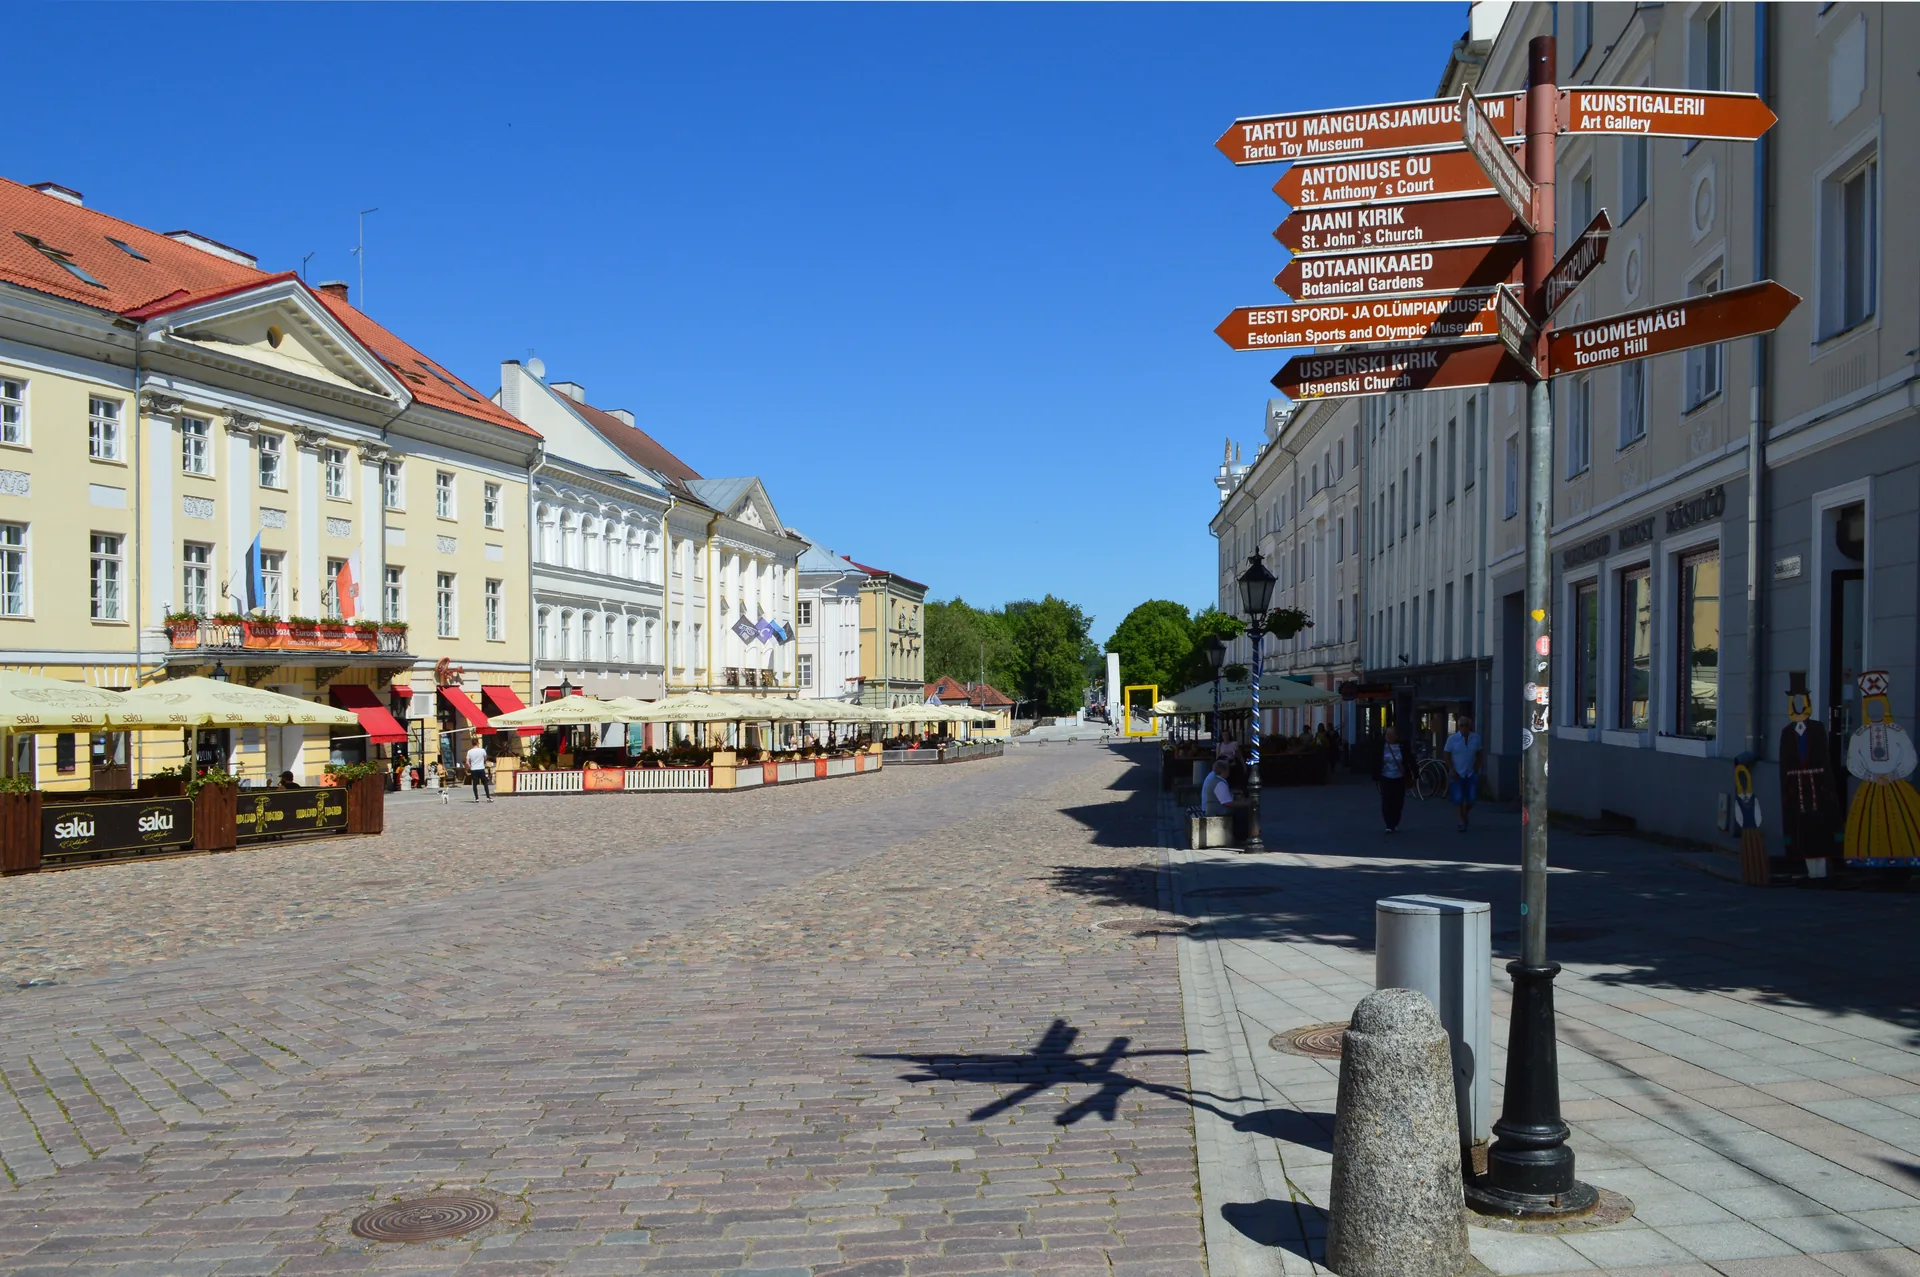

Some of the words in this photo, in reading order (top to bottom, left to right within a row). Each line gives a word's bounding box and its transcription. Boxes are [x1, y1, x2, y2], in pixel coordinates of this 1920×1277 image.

[1580, 94, 1705, 116] KUNSTIGALERII
[1242, 121, 1298, 142] TARTU
[1302, 100, 1506, 138] MÄNGUASJAMUUSM
[1580, 115, 1602, 129] Art
[1604, 114, 1652, 133] Gallery
[1243, 143, 1277, 159] Tartu
[1280, 141, 1303, 157] Toy
[1307, 136, 1364, 153] Museum
[1301, 161, 1401, 186] ANTONIUSE
[1405, 155, 1432, 175] ÕU
[1301, 189, 1319, 203] St.
[1397, 178, 1434, 193] Court
[1301, 210, 1353, 232] JAANI
[1357, 206, 1405, 228] KIRIK
[1301, 234, 1319, 249] St.
[1375, 227, 1423, 243] Church
[1301, 252, 1434, 279] BOTAANIKAAED
[1556, 226, 1601, 300] INFOPUNKT
[1301, 279, 1364, 296] Botanical
[1367, 275, 1424, 293] Gardens
[1247, 309, 1288, 325] EESTI
[1291, 307, 1349, 323] SPORDI-
[1352, 304, 1370, 319] JA
[1372, 297, 1497, 318] OLÜMPIAMUUSEU
[1247, 330, 1302, 345] Estonian
[1305, 328, 1347, 344] Sports
[1349, 325, 1372, 339] and
[1375, 322, 1427, 340] Olympic
[1430, 319, 1484, 335] Museum
[1572, 307, 1687, 350] TOOMEMÄGI
[1573, 347, 1620, 366] Toome
[1623, 337, 1649, 356] Hill
[1299, 355, 1386, 379] USPENSKI
[1391, 350, 1439, 372] KIRIK
[1363, 374, 1411, 391] Church
[251, 627, 274, 635] TARTU
[276, 628, 291, 636] 2024
[295, 629, 320, 639] Euroopa
[16, 713, 40, 724] saku
[71, 713, 93, 723] saku
[122, 713, 143, 722] saku
[169, 712, 188, 722] saku
[226, 713, 243, 721] saku
[264, 713, 280, 722] saku
[301, 713, 317, 722] saku
[334, 714, 349, 722] saku
[54, 816, 96, 839] saku
[138, 810, 173, 832] saku
